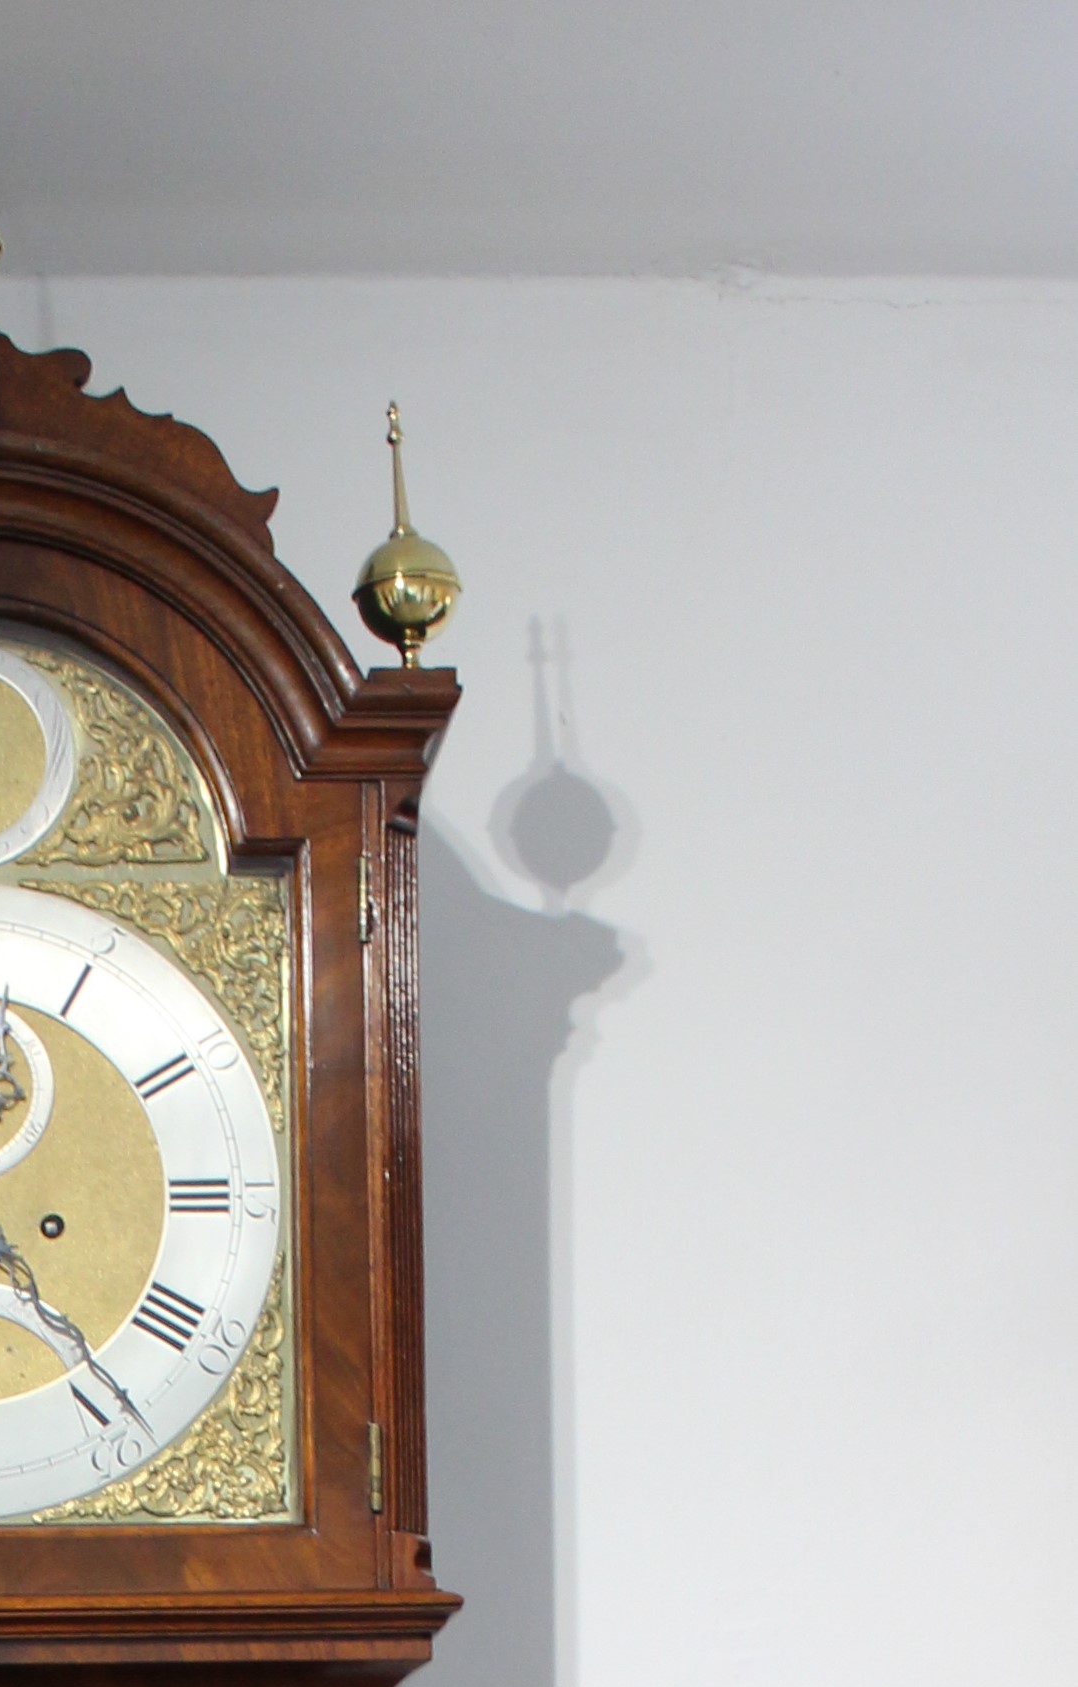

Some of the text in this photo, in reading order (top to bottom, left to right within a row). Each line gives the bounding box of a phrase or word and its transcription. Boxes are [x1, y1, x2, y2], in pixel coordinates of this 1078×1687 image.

[90, 926, 129, 957] 5
[197, 1030, 240, 1072] 10
[244, 1180, 277, 1226] 15
[198, 1315, 246, 1377] 20
[89, 1436, 145, 1475] 25
